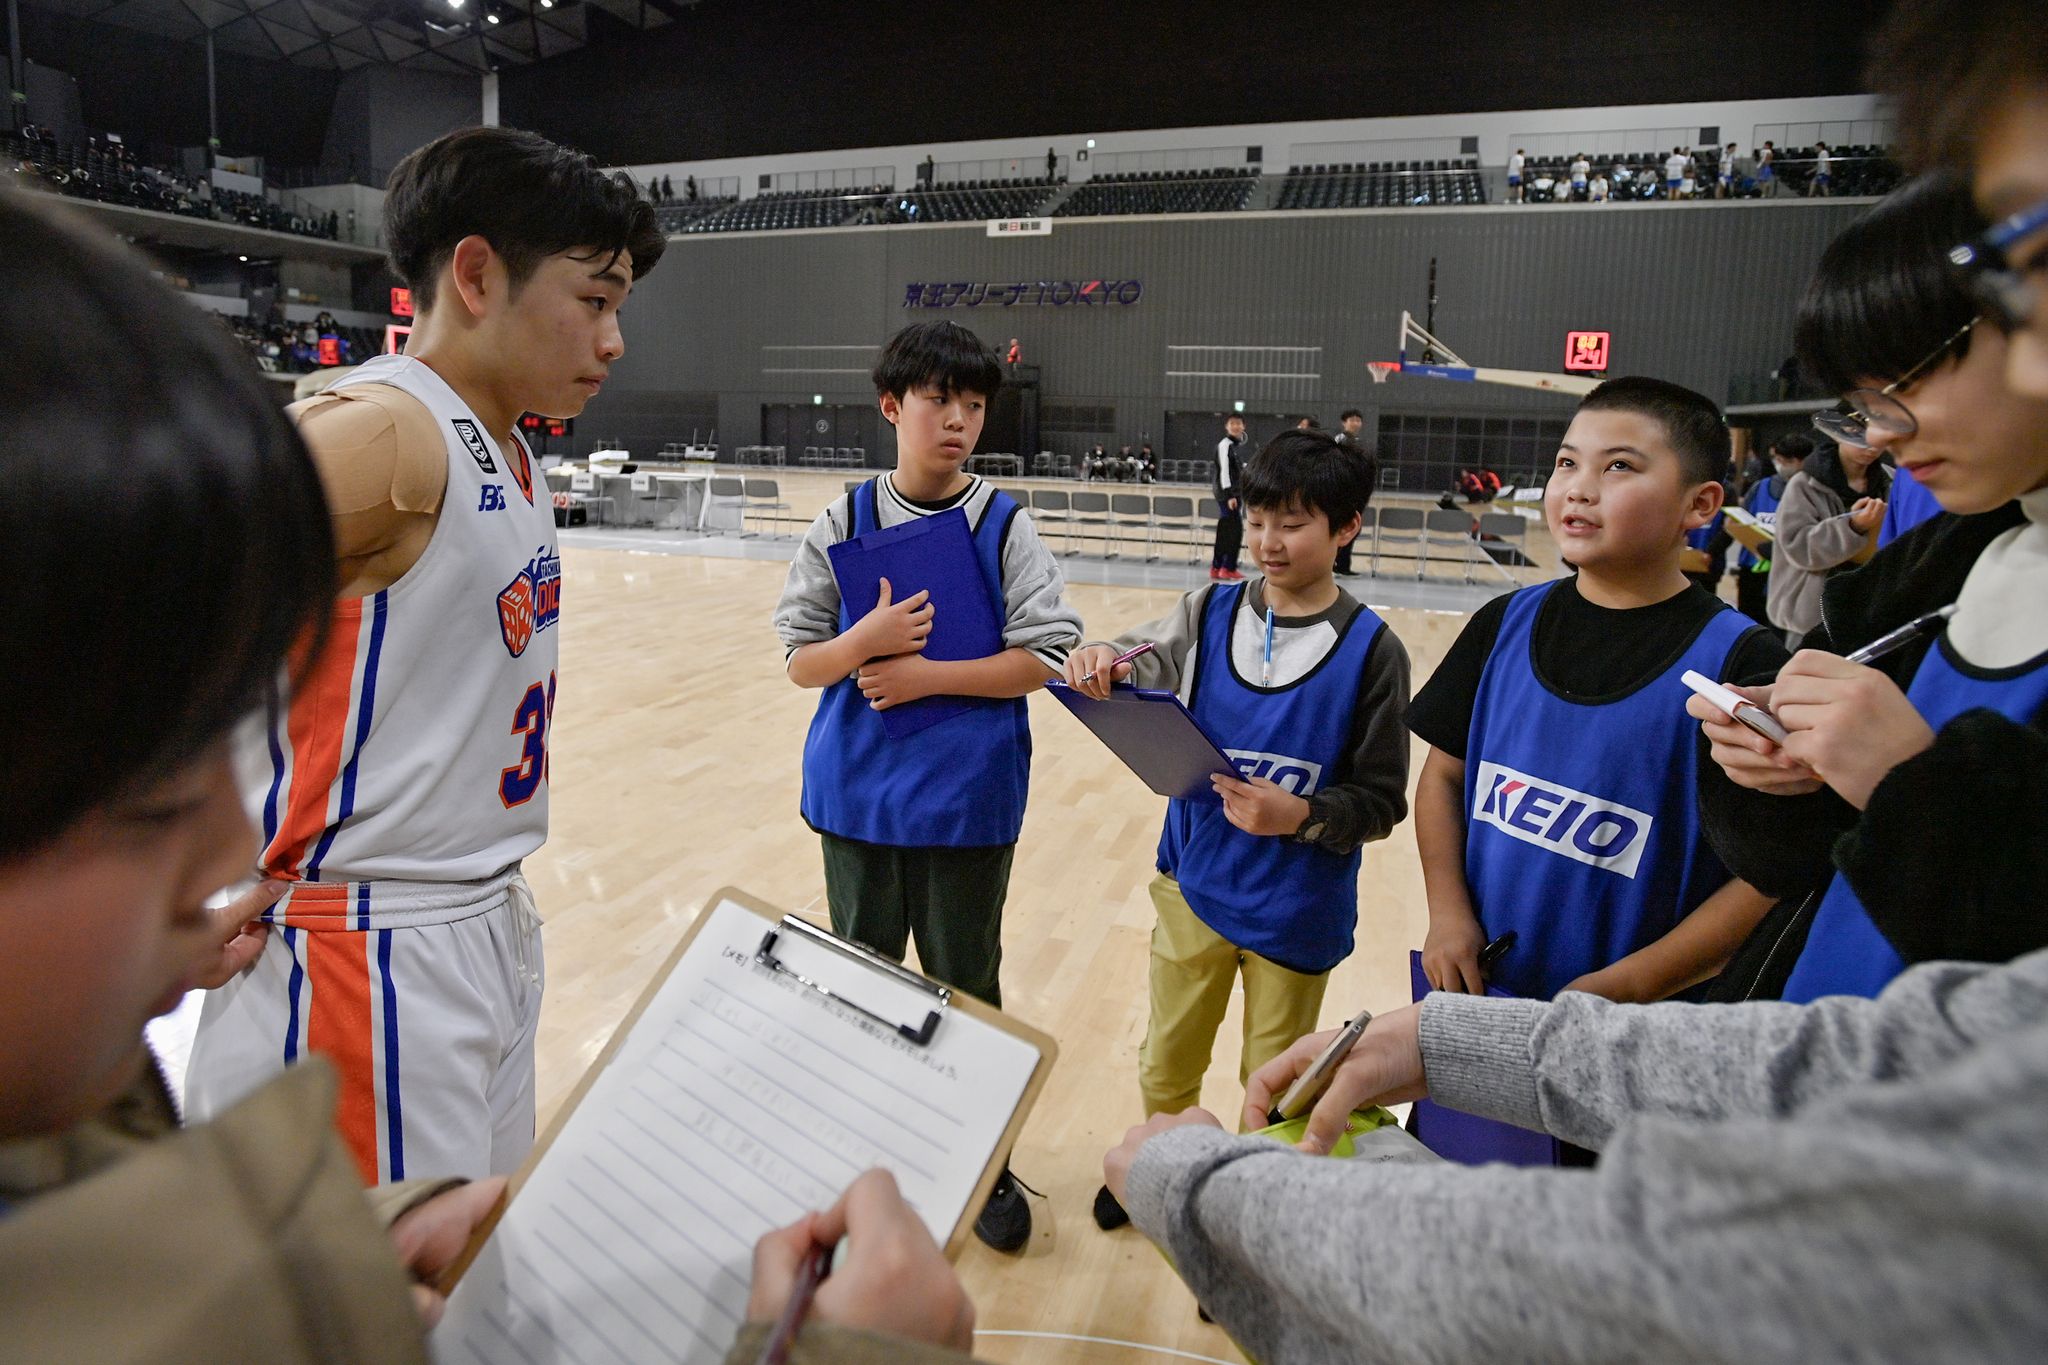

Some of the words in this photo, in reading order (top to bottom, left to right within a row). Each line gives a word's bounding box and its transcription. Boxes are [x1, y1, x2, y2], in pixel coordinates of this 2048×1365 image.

[1036, 279, 1142, 306] TOKYO
[1573, 349, 1601, 365] 24
[1231, 757, 1311, 797] EIO
[1482, 773, 1639, 858] KEIO
